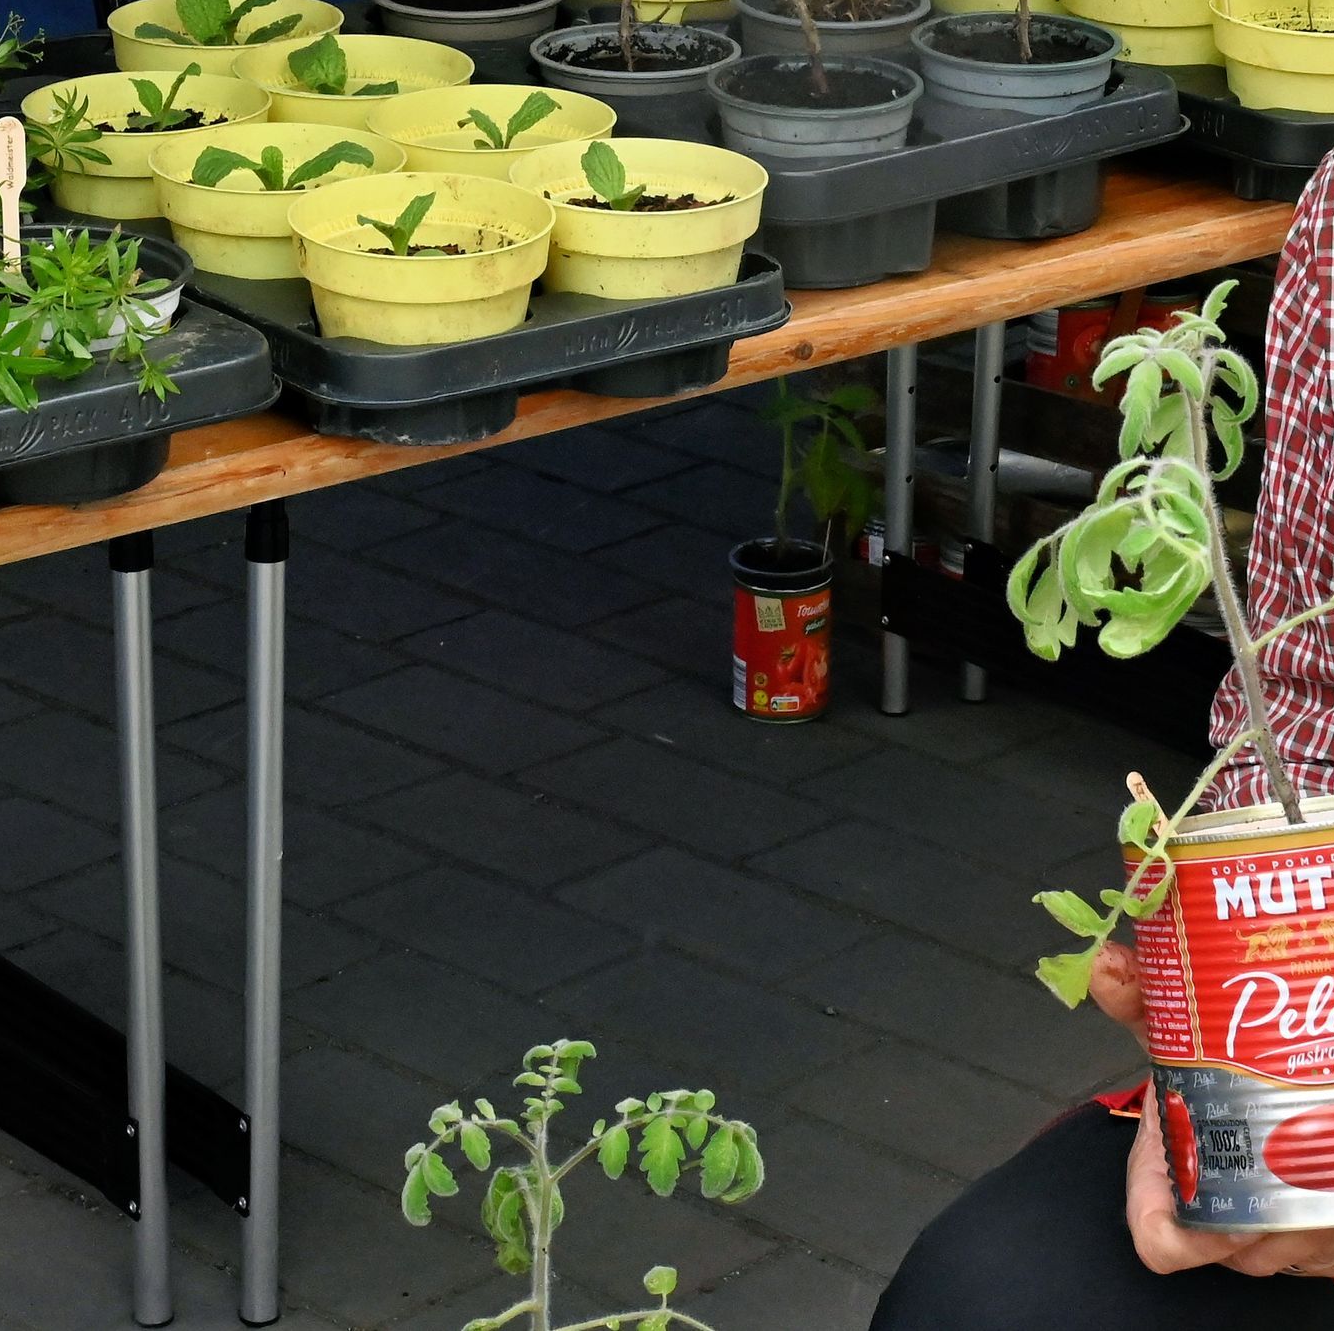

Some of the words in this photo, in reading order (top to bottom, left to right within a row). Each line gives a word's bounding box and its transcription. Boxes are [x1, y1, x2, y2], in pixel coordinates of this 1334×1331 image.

[7, 134, 15, 189] Waldmeister
[1211, 865, 1257, 876] SOLO
[1290, 957, 1332, 975] PARMA
[1209, 1129, 1240, 1153] 100%
[1208, 1154, 1247, 1171] ITALIANO
